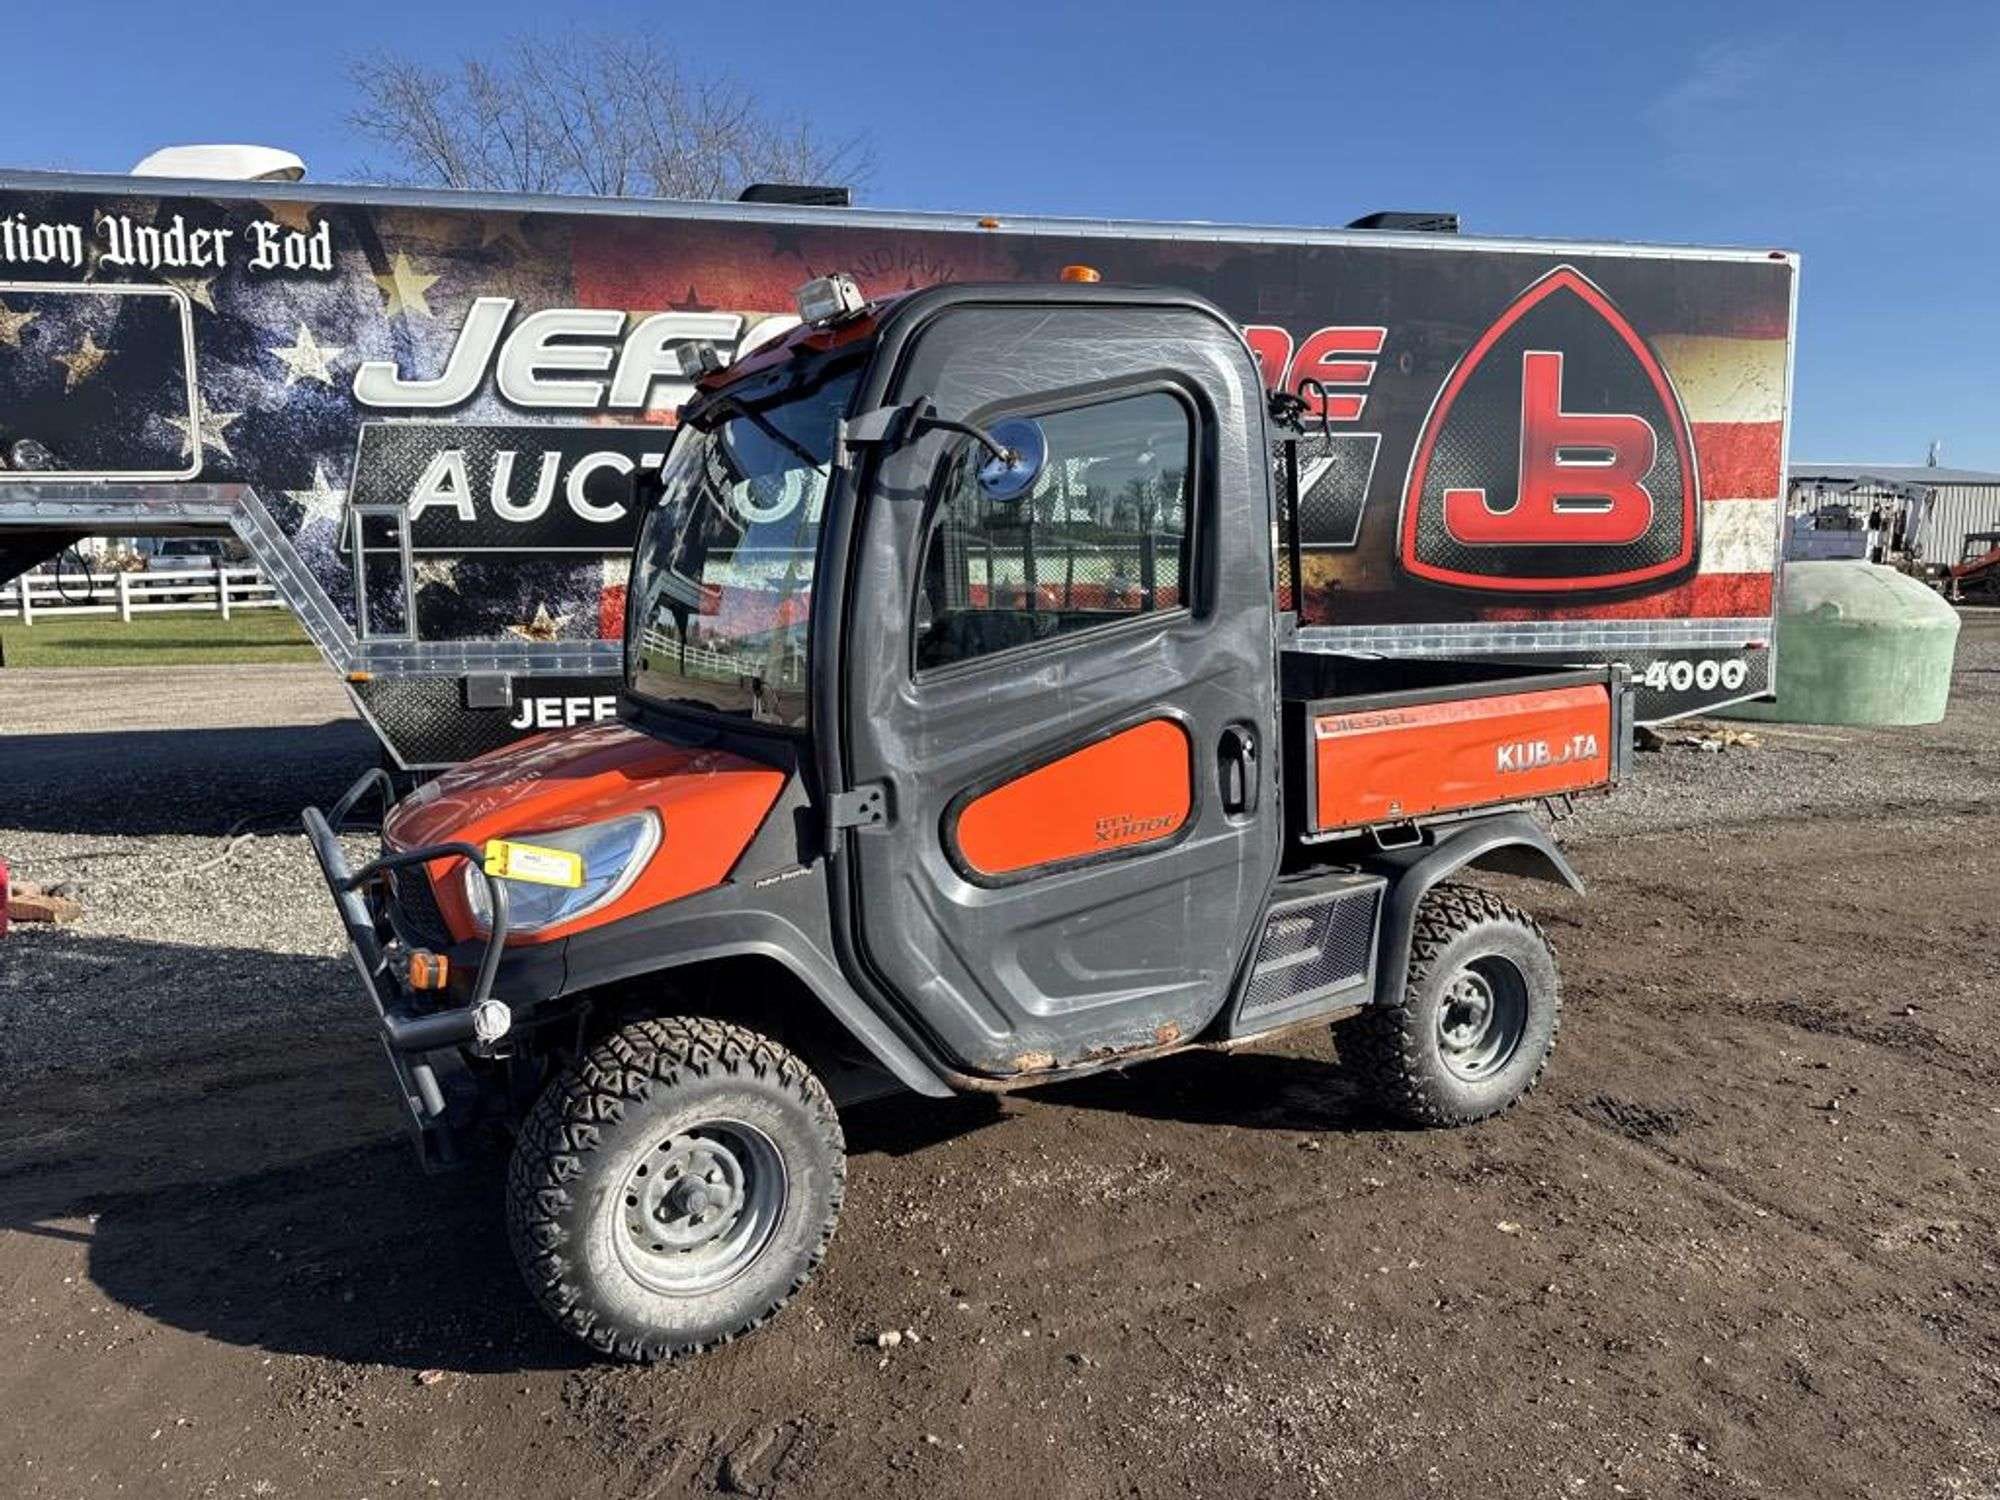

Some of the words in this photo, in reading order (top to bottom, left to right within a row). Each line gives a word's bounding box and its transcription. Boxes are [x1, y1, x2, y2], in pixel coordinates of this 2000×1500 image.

[96, 213, 234, 270] Under
[245, 219, 334, 272] God
[1443, 350, 1656, 546] JB
[510, 696, 617, 729] JEFF
